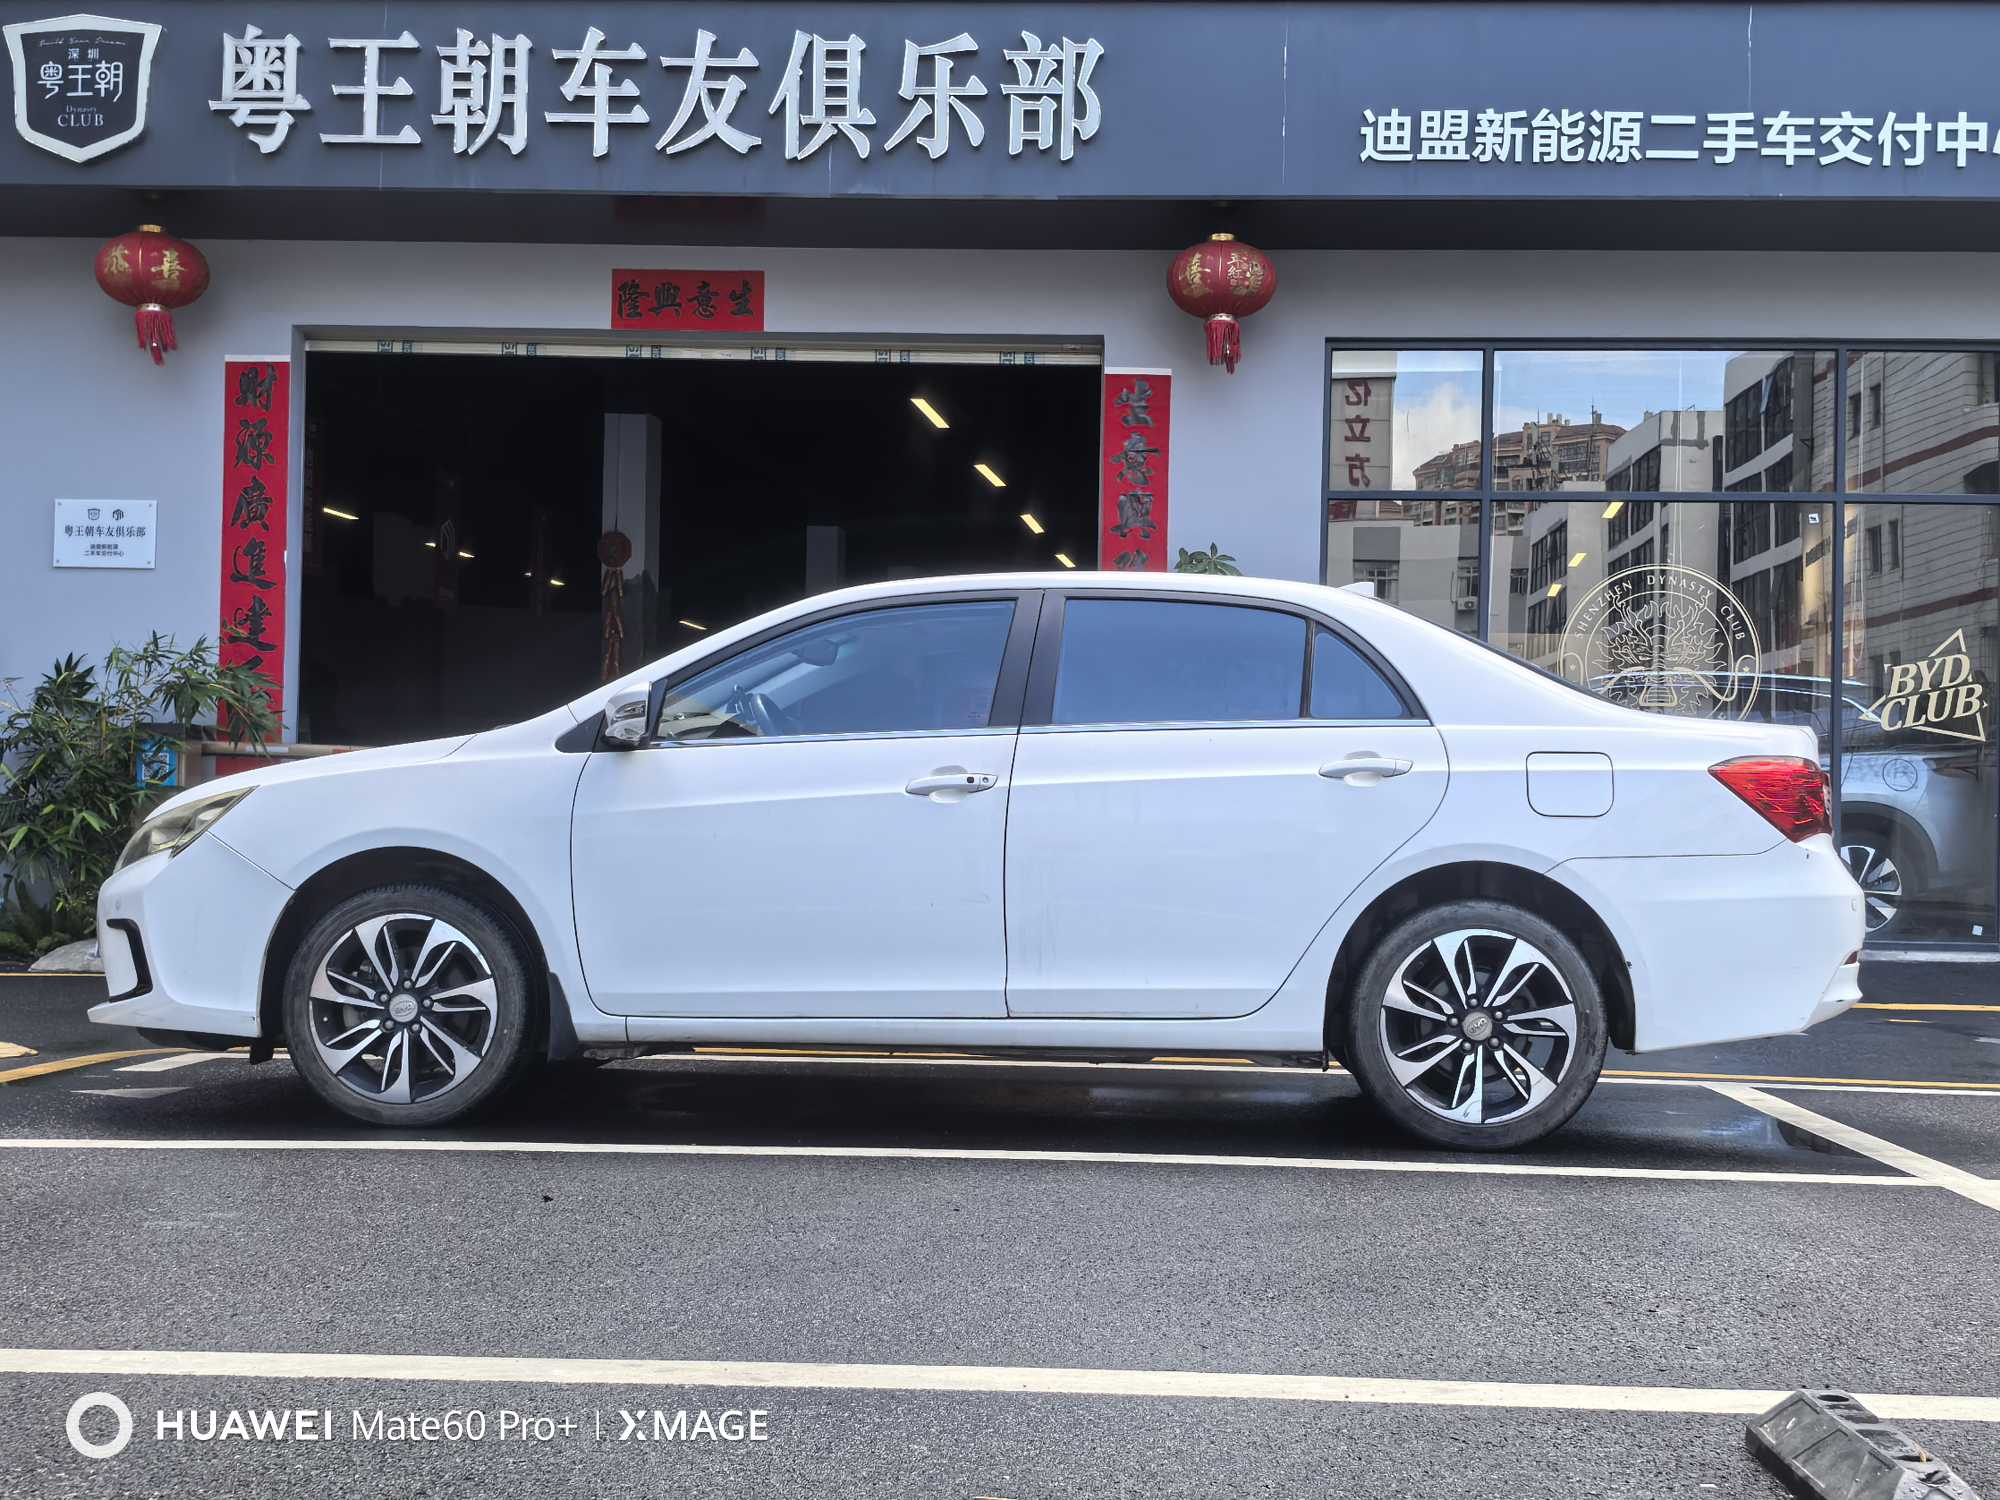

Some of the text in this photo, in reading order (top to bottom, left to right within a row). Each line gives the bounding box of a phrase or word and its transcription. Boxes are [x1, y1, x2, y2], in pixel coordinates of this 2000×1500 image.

[68, 48, 100, 60] 深圳
[37, 60, 124, 103] 粤王朝
[208, 24, 1104, 161] 粤王朝车友俱乐部
[57, 114, 104, 127] CLUB
[1359, 108, 2000, 168] 迪盟新能源二手车交付中
[1574, 574, 1747, 641] SHENZHEN DYNASTY CLUB
[1887, 653, 1970, 698] BYD
[1880, 683, 1983, 731] CLUB
